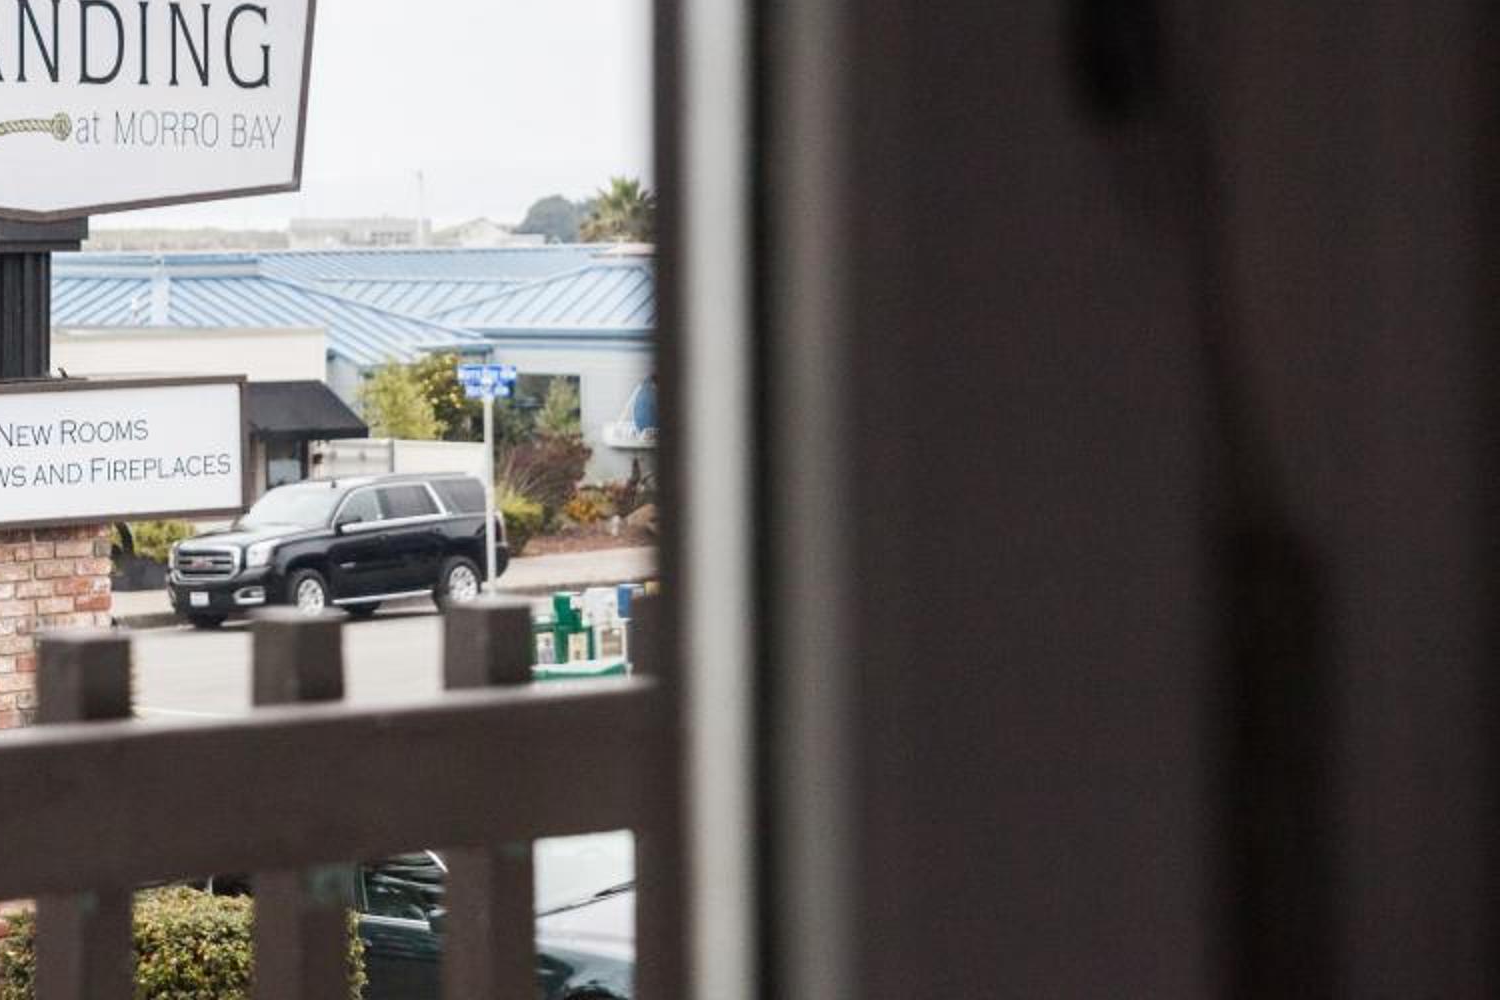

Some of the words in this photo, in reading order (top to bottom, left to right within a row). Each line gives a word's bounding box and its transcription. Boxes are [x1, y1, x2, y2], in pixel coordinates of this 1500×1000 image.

[75, 112, 101, 145] at
[114, 110, 219, 148] MORRO
[231, 113, 282, 149] BAY
[60, 419, 149, 445] ROOMS
[33, 462, 83, 487] AND
[90, 453, 231, 484] FIREPLACES
